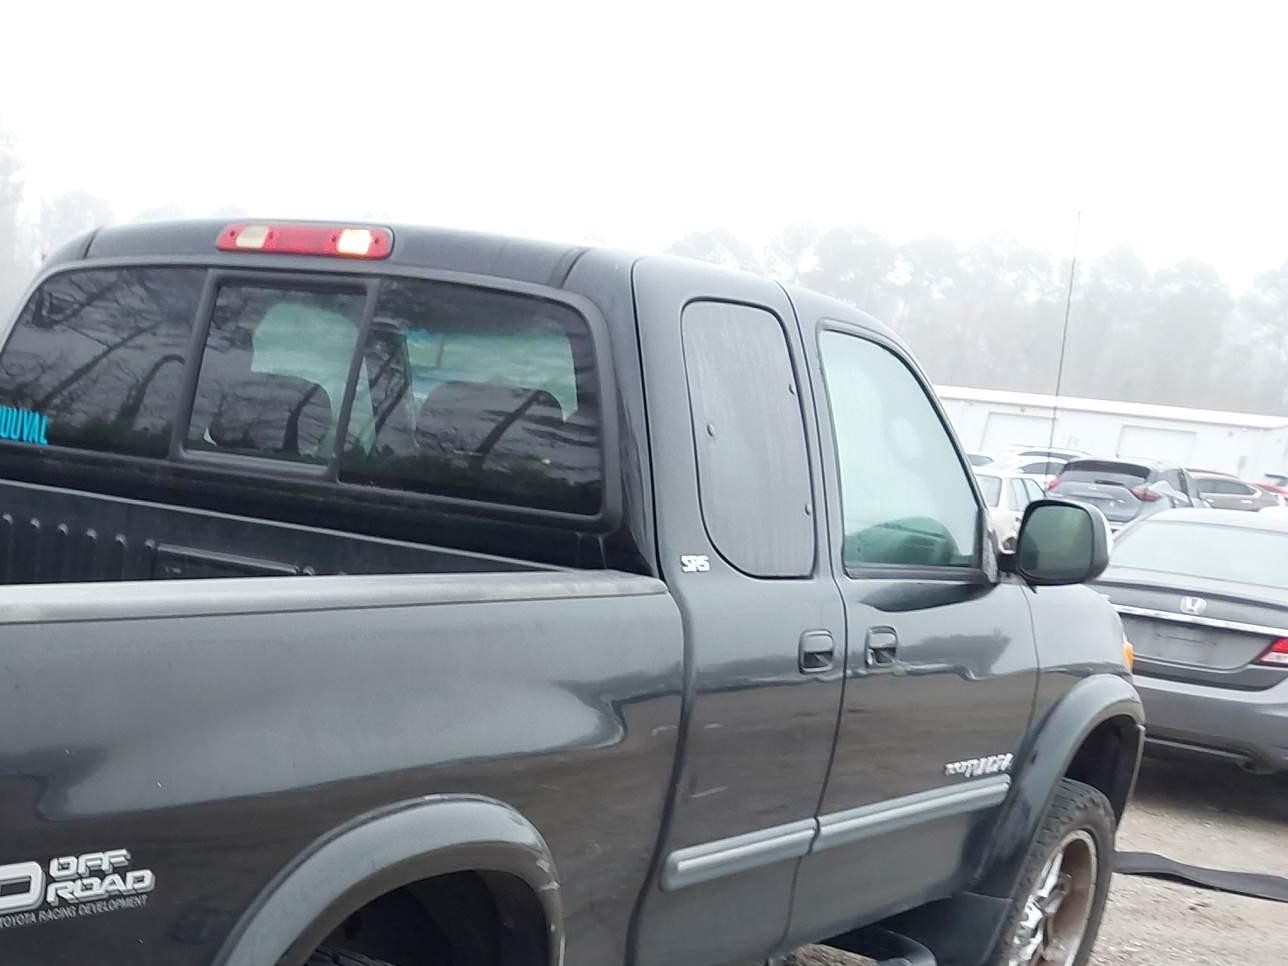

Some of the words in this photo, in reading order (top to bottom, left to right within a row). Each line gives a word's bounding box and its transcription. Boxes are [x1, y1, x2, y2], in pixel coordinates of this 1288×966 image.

[681, 555, 710, 572] SR5
[49, 848, 132, 880] OFF
[46, 869, 157, 906] ROAD
